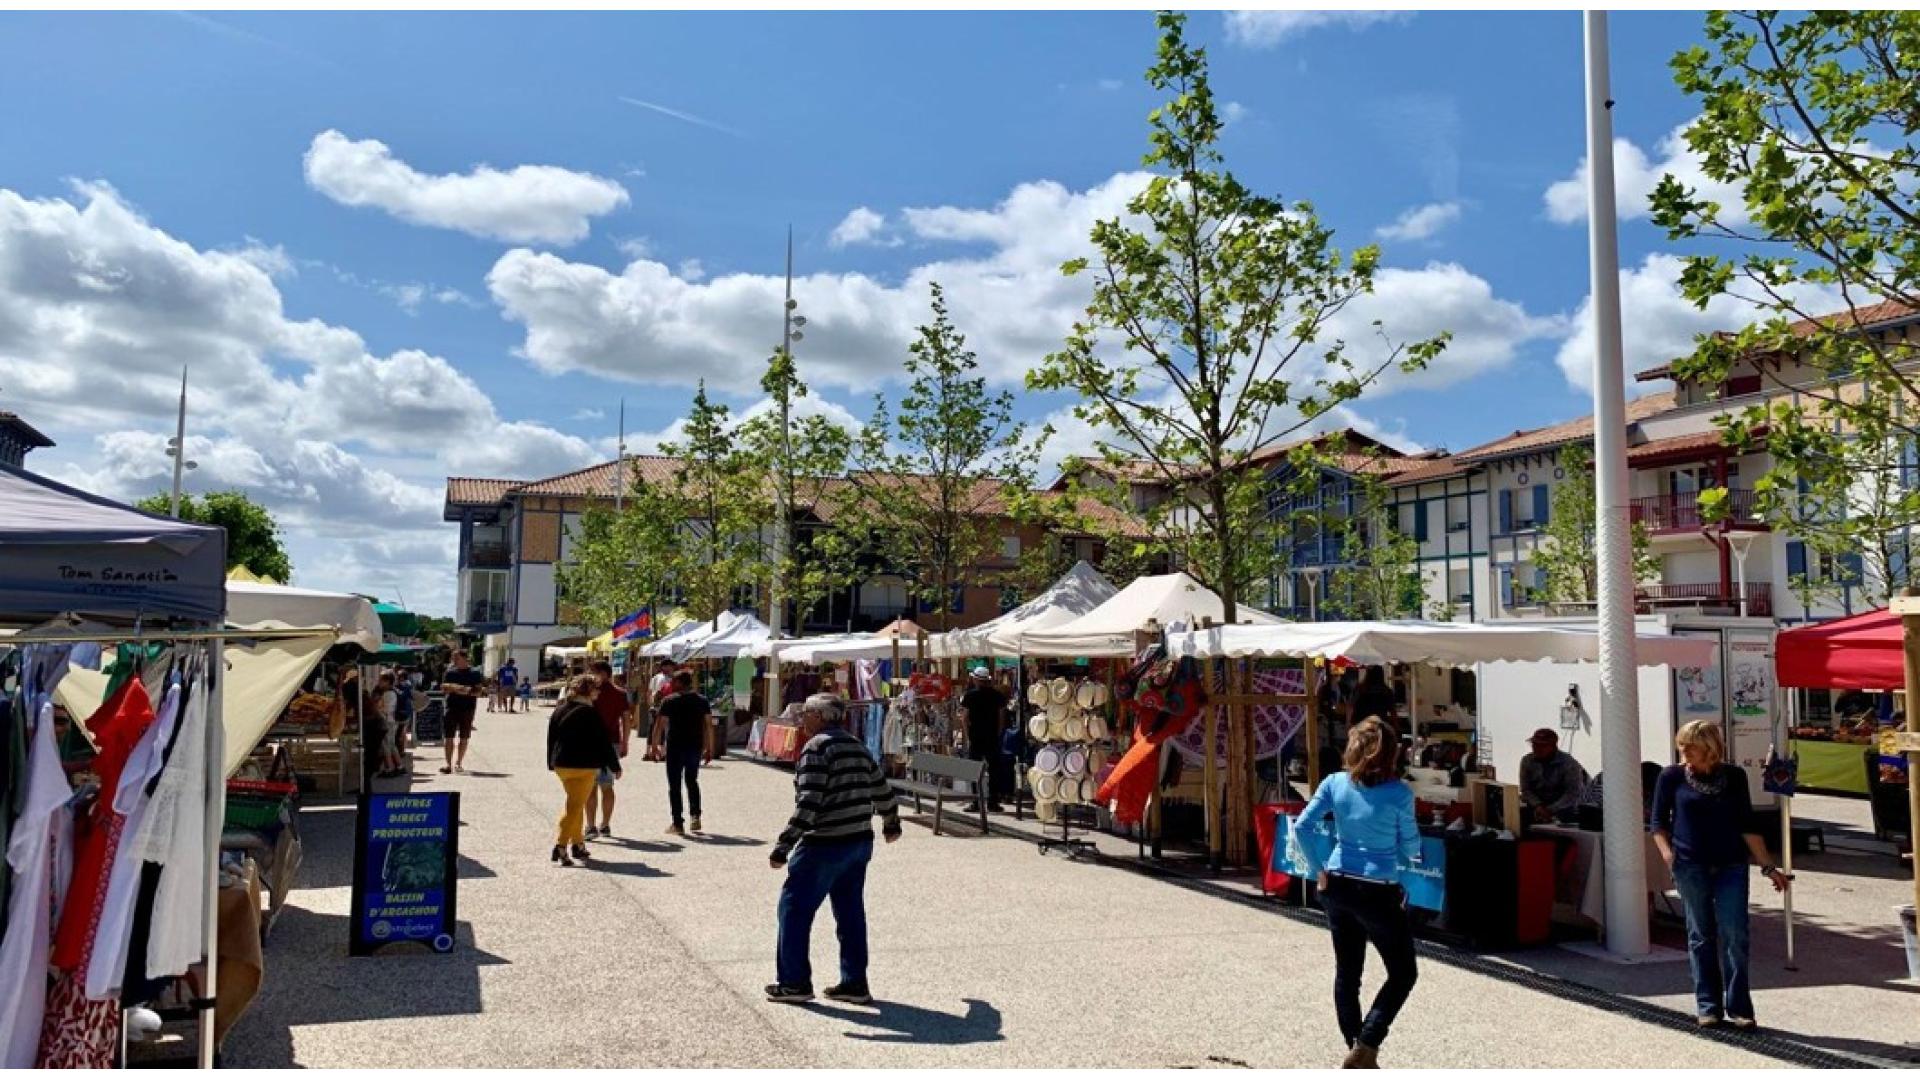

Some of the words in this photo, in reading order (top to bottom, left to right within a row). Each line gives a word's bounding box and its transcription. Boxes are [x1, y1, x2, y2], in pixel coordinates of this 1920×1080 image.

[58, 565, 93, 580] Tom
[388, 813, 429, 823] DIRECT
[372, 827, 443, 839] PRODUCTEUR
[385, 892, 425, 904] BASSIN
[369, 905, 440, 918] D'ARCACHON
